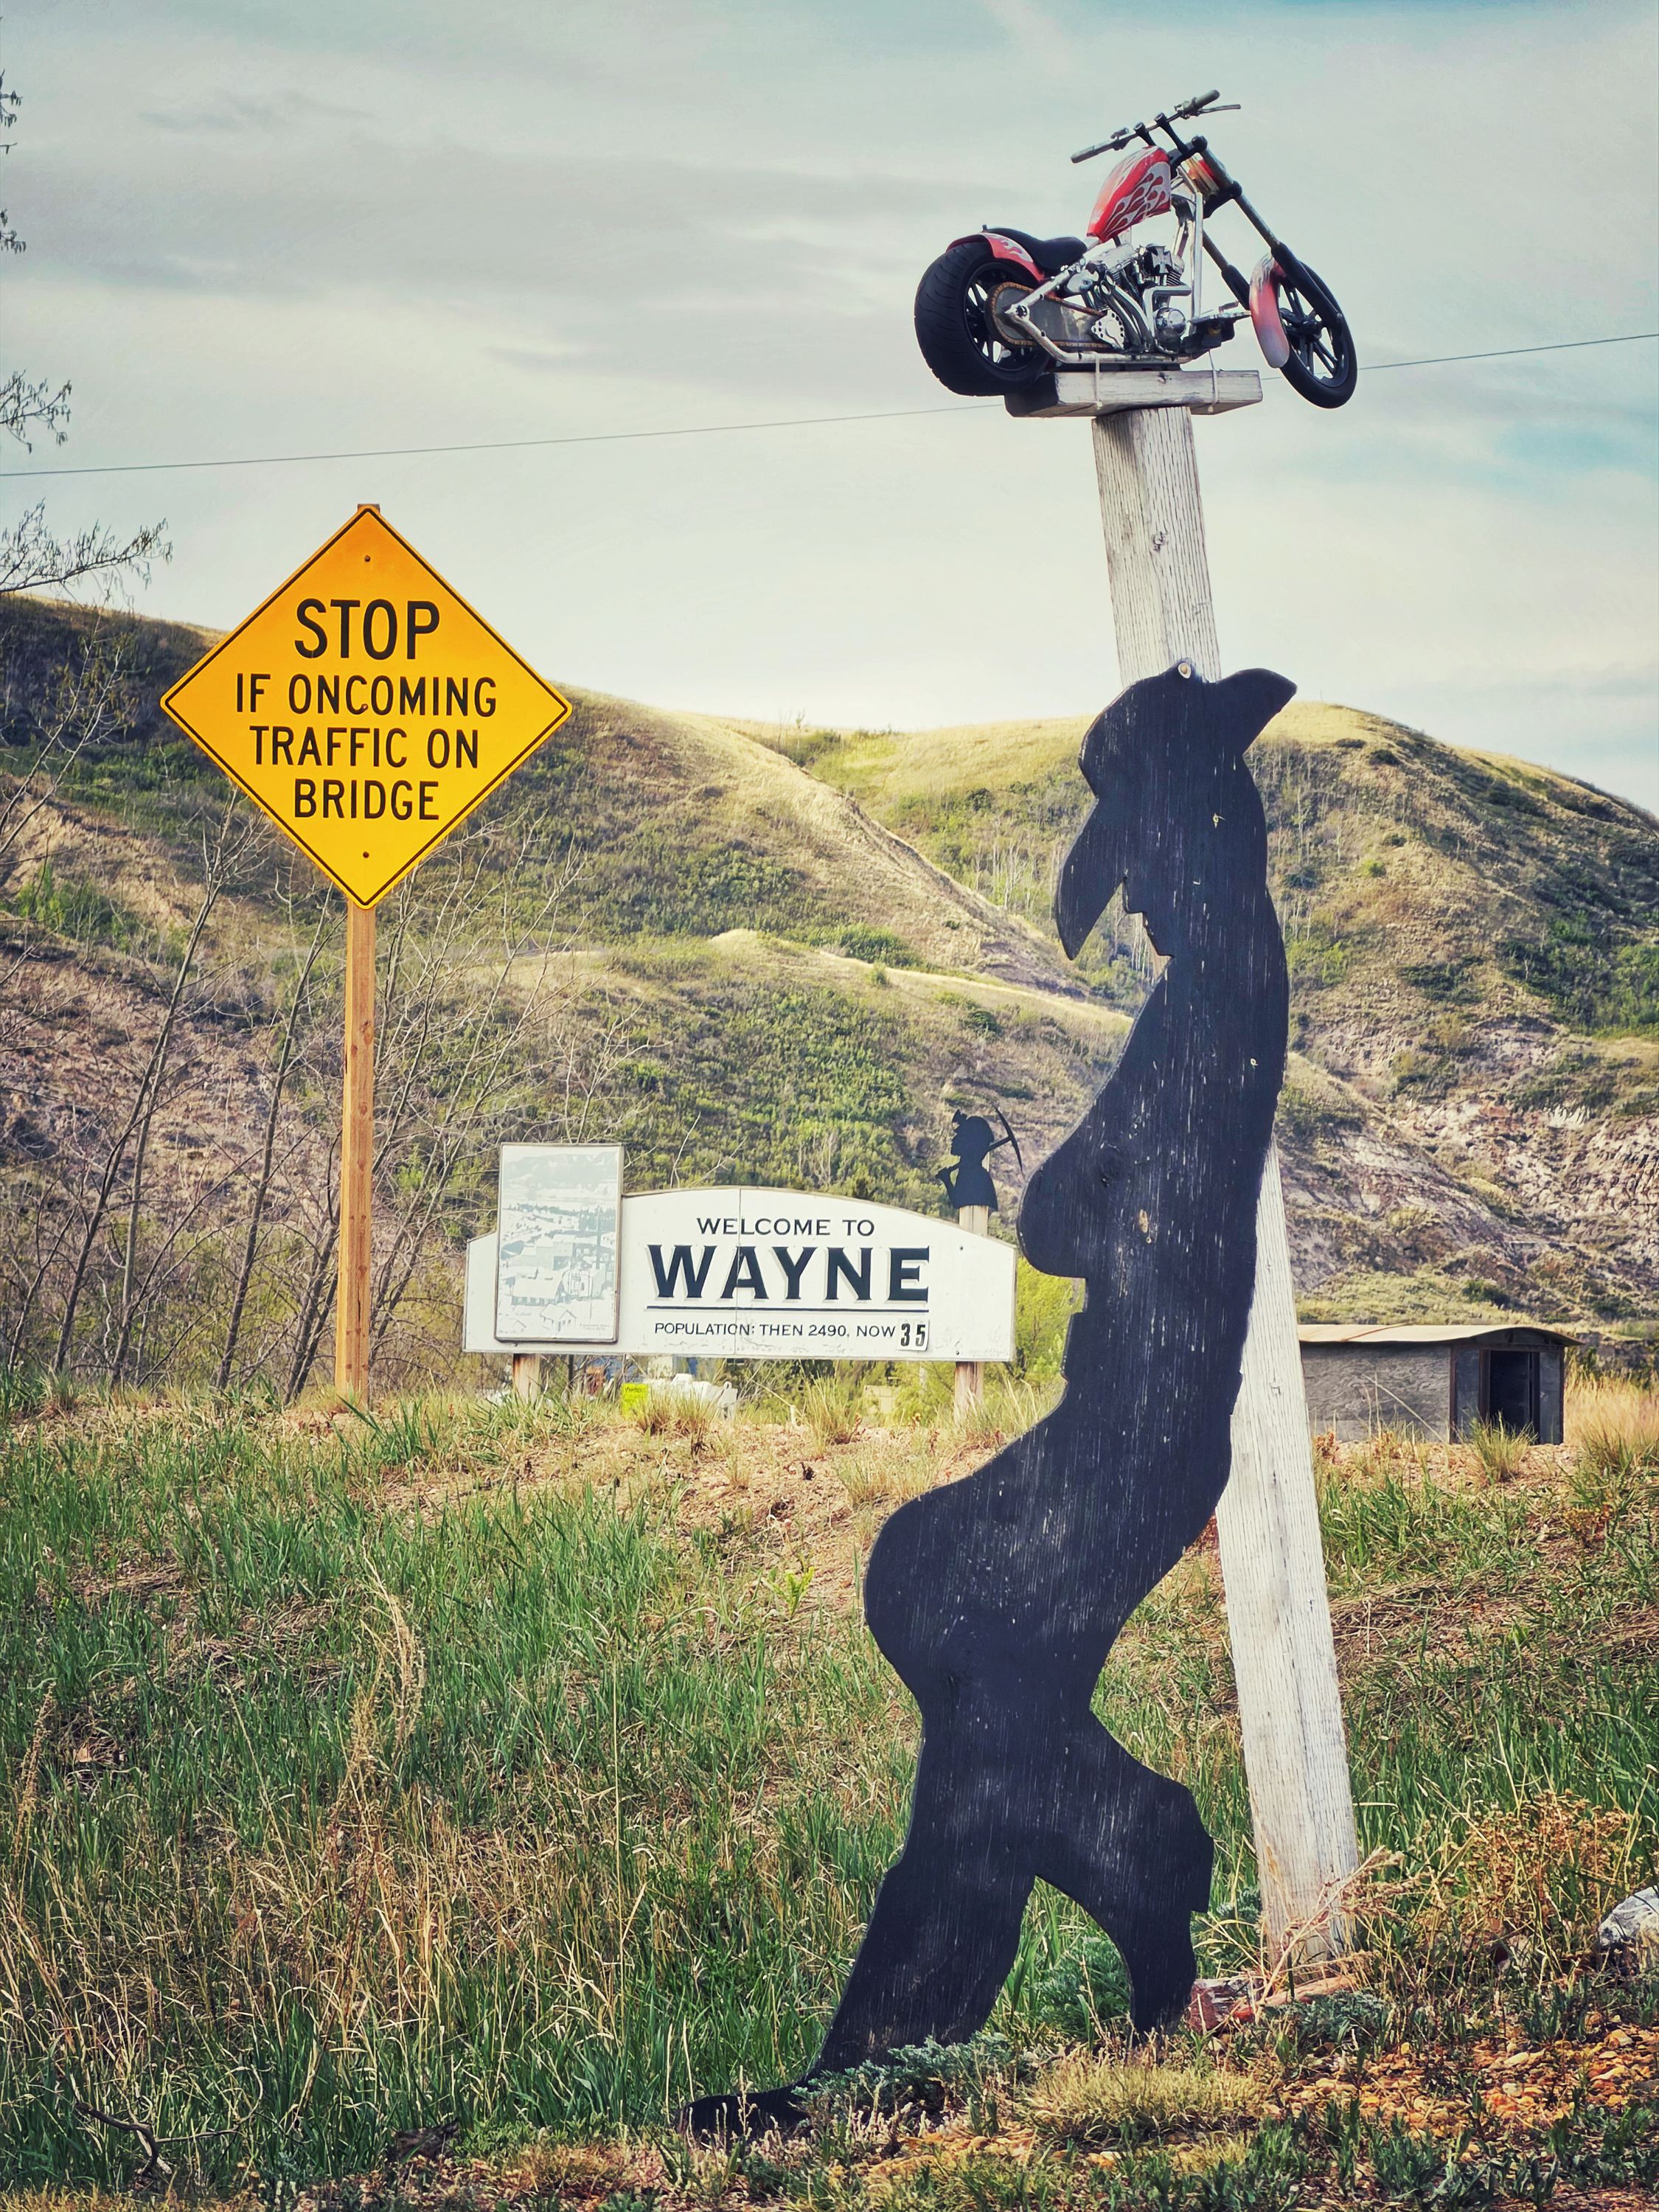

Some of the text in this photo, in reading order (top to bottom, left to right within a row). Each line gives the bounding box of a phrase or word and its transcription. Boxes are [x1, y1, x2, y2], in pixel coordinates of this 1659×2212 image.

[294, 599, 440, 659] STOP
[236, 673, 496, 717] IF ONCOMING
[249, 726, 479, 769] TRAFFIC ON
[294, 779, 439, 821] BRIDGE
[696, 1217, 875, 1237] WELCOME TO
[646, 1244, 931, 1304] WAYNE
[654, 1322, 755, 1336] POPULATION:
[759, 1324, 803, 1337] THEN
[856, 1326, 897, 1338] NOW
[900, 1323, 927, 1347] 35
